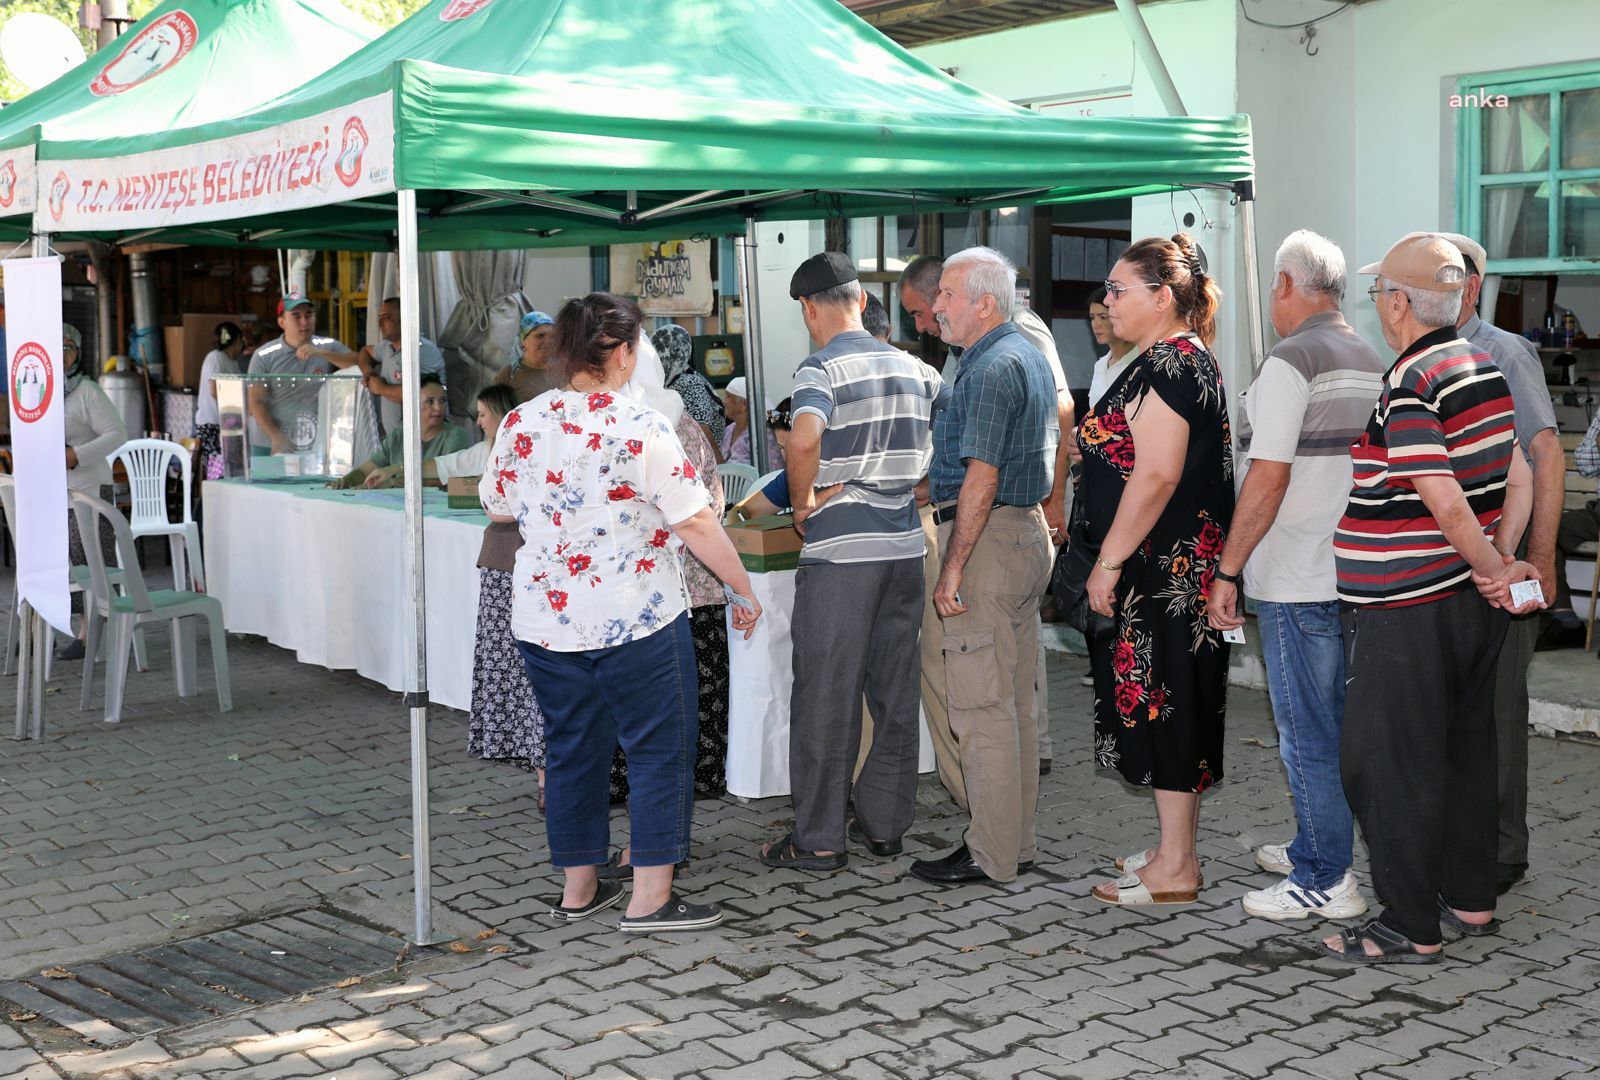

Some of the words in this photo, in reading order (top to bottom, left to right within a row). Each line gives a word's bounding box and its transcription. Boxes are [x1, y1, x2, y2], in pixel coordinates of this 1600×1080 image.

[77, 179, 108, 213] T.C.
[108, 166, 199, 214] MENTEŞE
[203, 125, 329, 205] BELEDİYESİ
